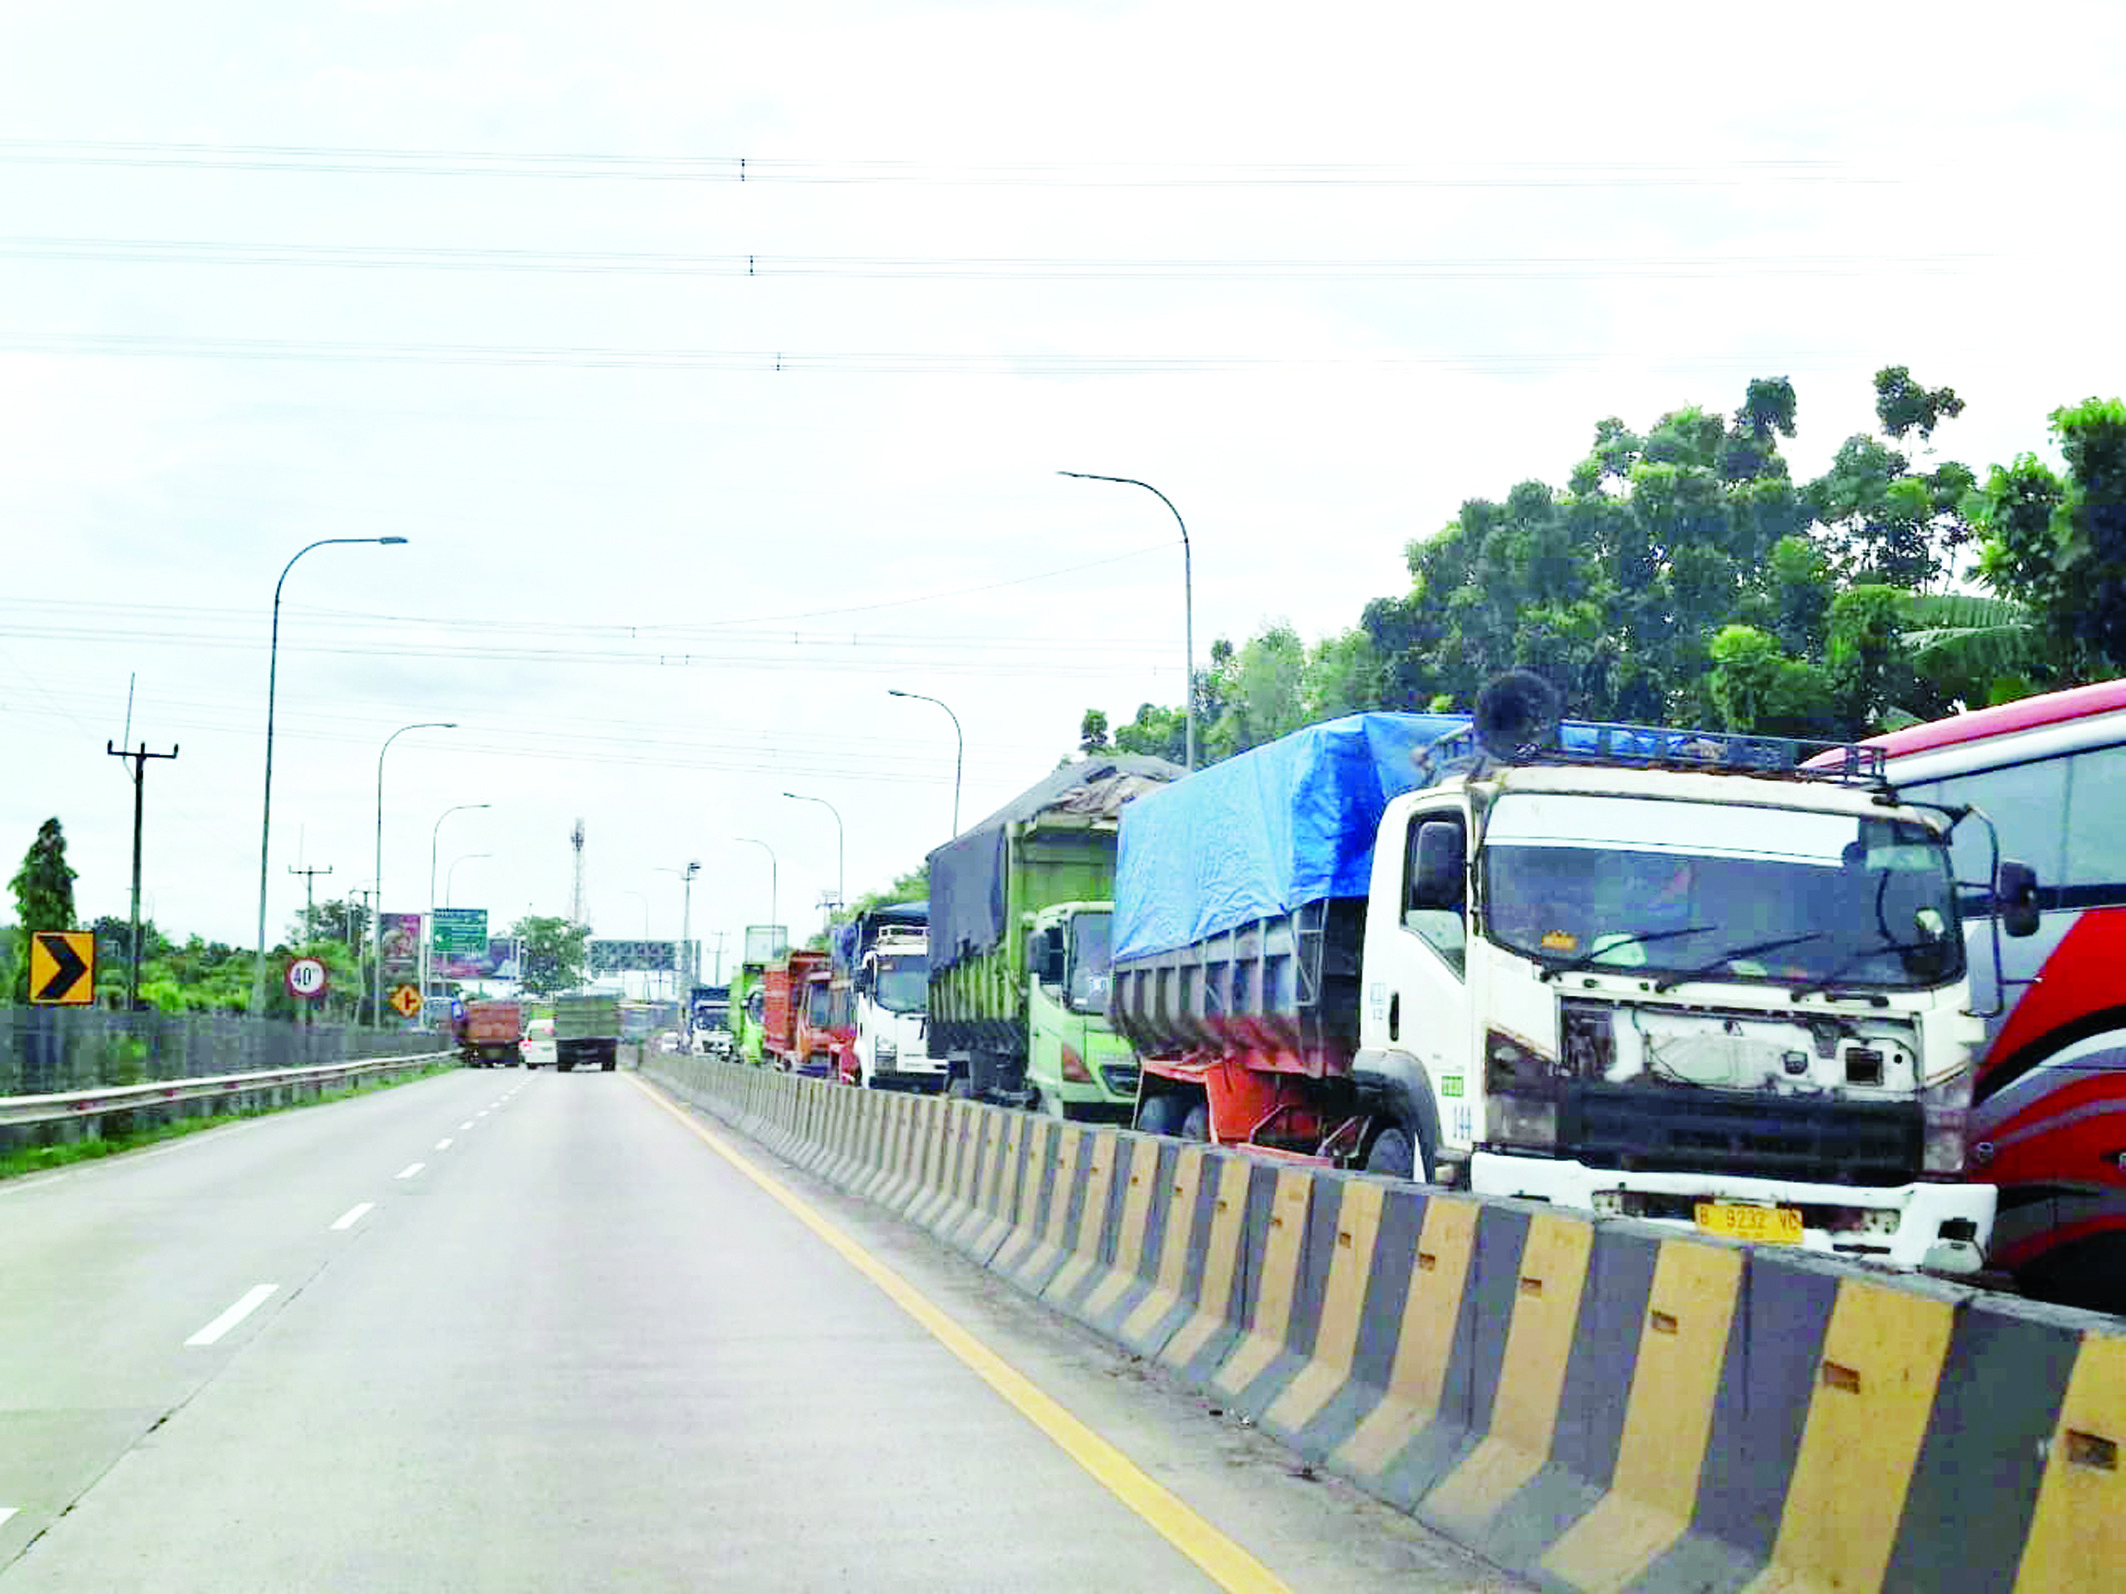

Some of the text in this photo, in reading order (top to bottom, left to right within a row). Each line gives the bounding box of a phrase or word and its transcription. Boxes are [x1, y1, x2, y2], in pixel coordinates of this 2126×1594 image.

[293, 967, 311, 986] 40
[1700, 1206, 1709, 1226] B
[1726, 1208, 1767, 1230] 9232
